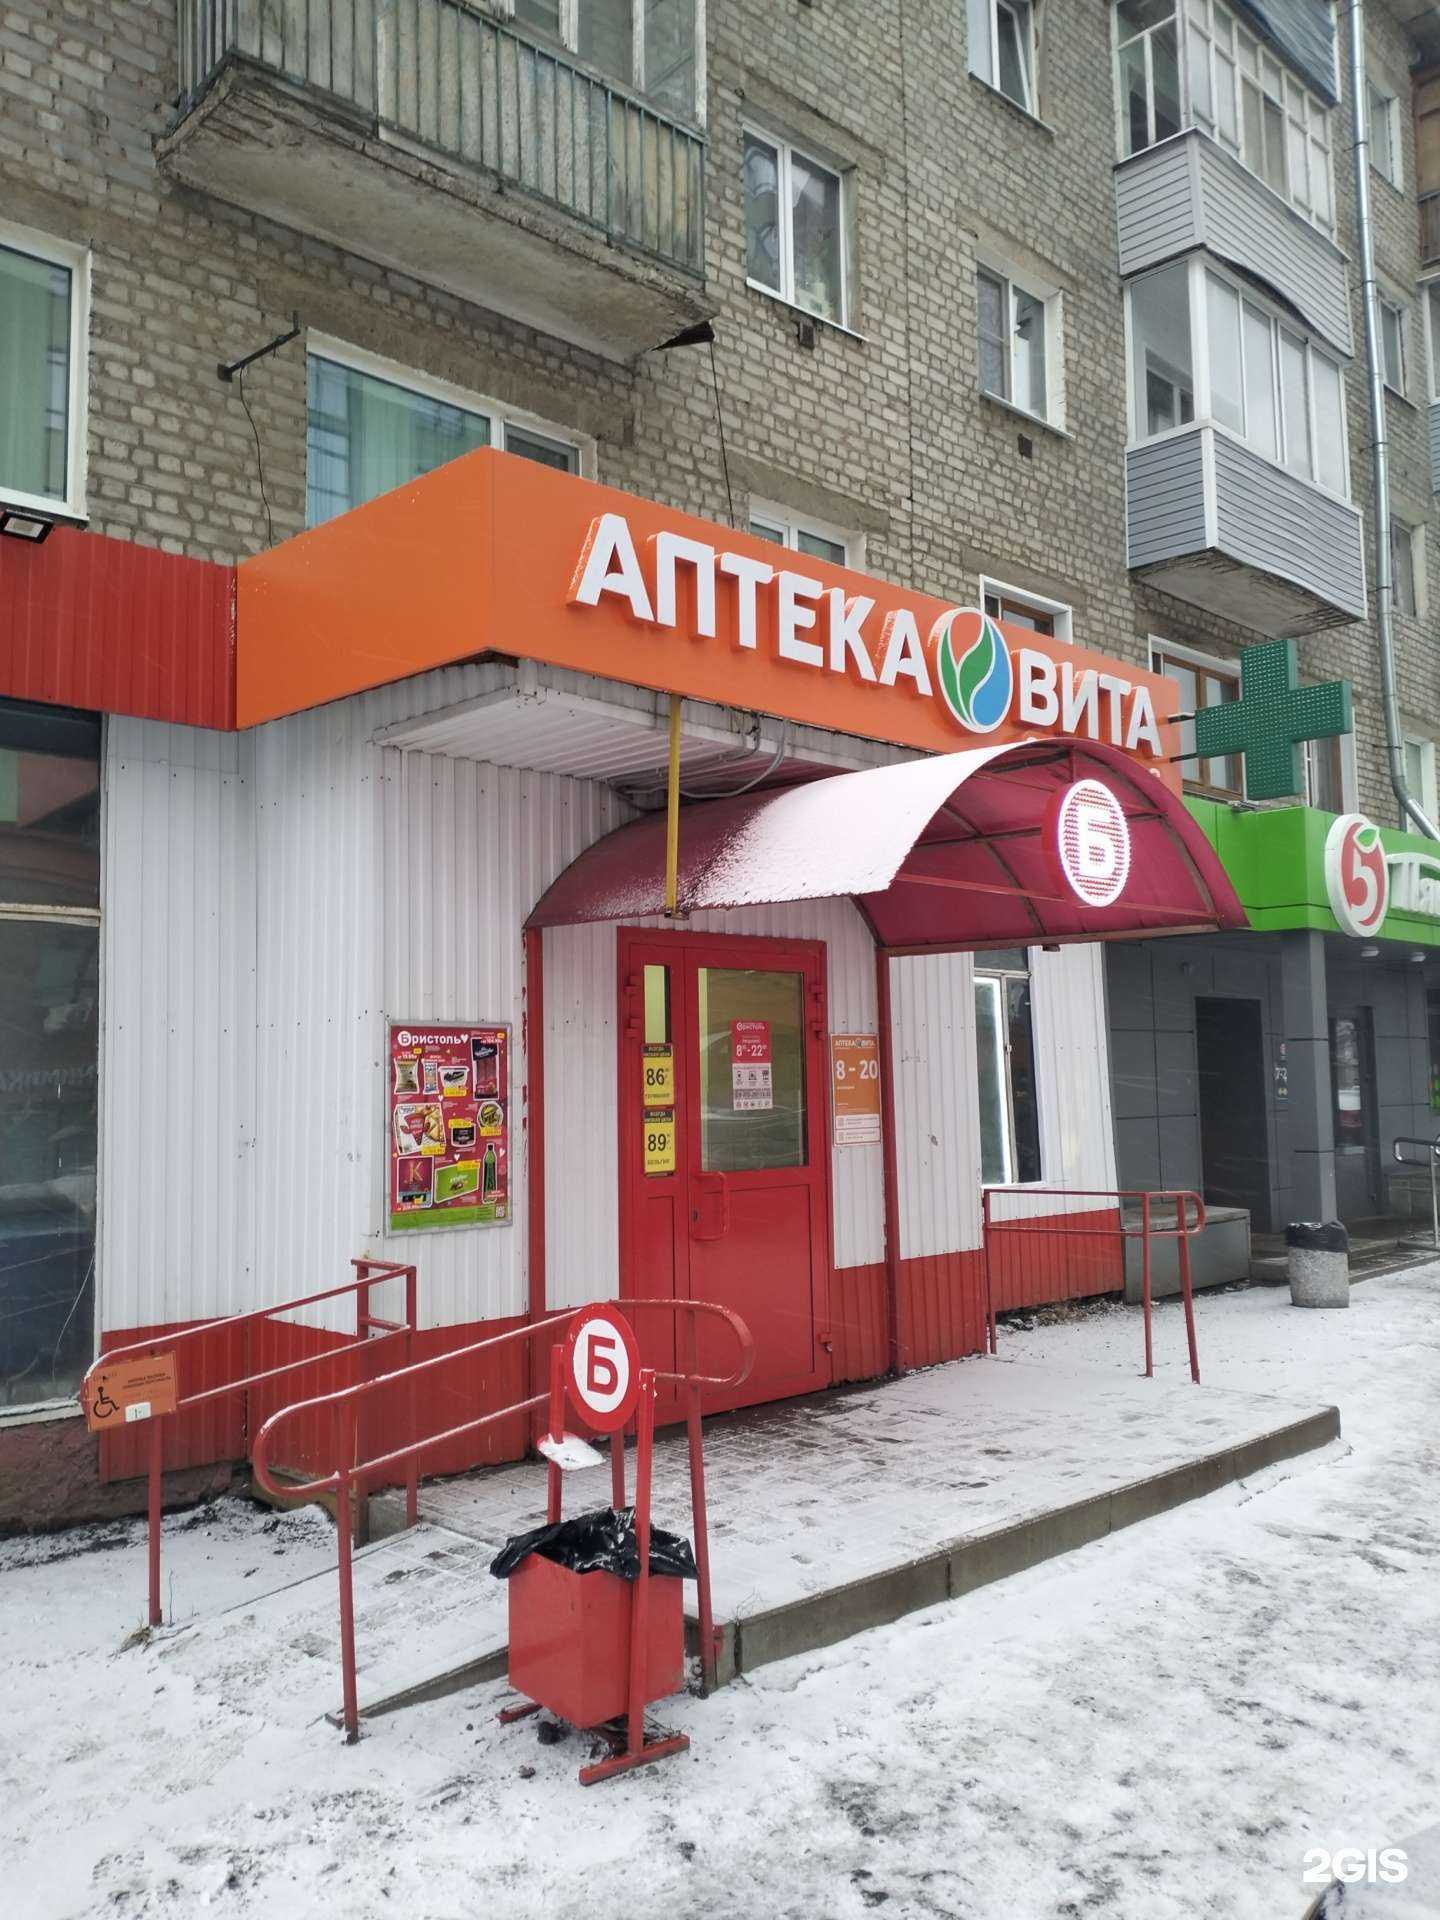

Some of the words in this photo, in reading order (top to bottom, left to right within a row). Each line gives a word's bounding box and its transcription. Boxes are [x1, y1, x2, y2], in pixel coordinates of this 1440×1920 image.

[568, 513, 934, 696] АПТЕКА
[1012, 648, 1164, 758] ВИТА
[1078, 804, 1116, 879] Б
[397, 1031, 463, 1047] Бристоль
[646, 1068, 664, 1086] 86
[836, 1059, 846, 1080] 8
[859, 1059, 879, 1080] 20
[647, 1133, 666, 1152] 89
[586, 1333, 619, 1396] Б
